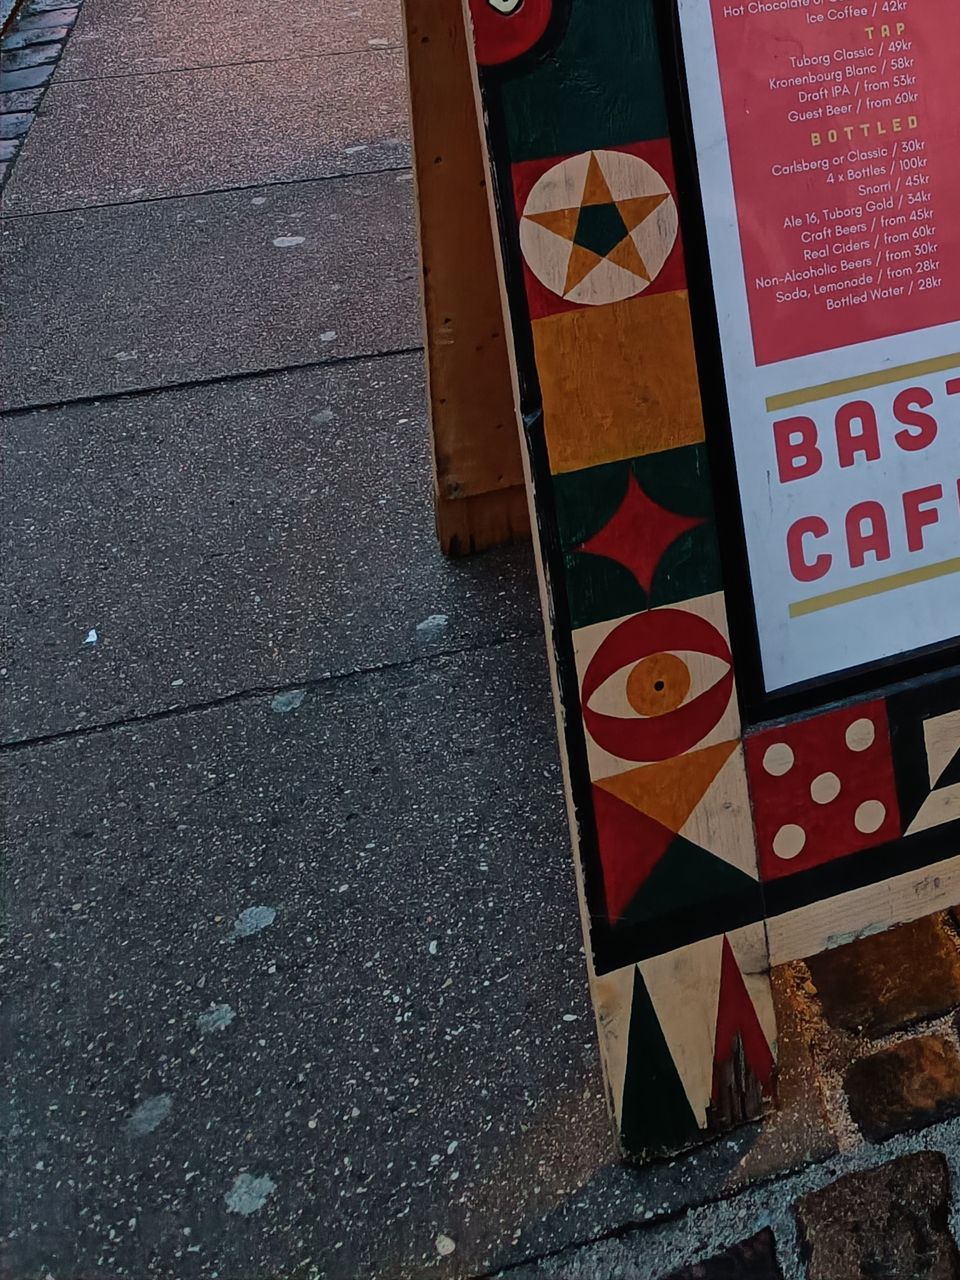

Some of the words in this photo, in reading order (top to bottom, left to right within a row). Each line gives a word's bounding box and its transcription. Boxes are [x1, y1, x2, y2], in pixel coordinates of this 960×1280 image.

[806, 12, 824, 23] Ice
[827, 5, 868, 20] Coffee
[864, 22, 905, 39] TAP
[789, 54, 830, 68] Tuborg
[833, 46, 874, 61] Classic
[887, 38, 912, 52] 49kr
[769, 70, 843, 89] Kronenbourg
[845, 64, 877, 78] Blanc
[890, 55, 914, 70] 58kr
[798, 86, 828, 103] Draft
[831, 84, 851, 97] IPA
[863, 79, 890, 92] from
[893, 73, 916, 87] 53kr
[787, 107, 823, 122] Guest
[825, 104, 852, 116] Beer
[865, 96, 892, 109] from
[894, 90, 918, 104] 60kr
[810, 115, 917, 146] BOTTLED
[800, 226, 832, 243] Craft
[834, 223, 867, 237] Beers
[880, 215, 906, 227] from
[909, 207, 933, 221] 45kr
[803, 243, 829, 261] Real
[832, 239, 870, 255] Ciders
[883, 232, 909, 244] from
[911, 224, 935, 239] 60kr
[755, 262, 837, 289] Non-Alcoholic
[840, 257, 872, 271] Beers
[885, 249, 912, 262] from
[913, 241, 938, 256] 30kr
[826, 290, 868, 310] Bottled
[869, 286, 904, 301] Water
[917, 275, 941, 290] 28kr
